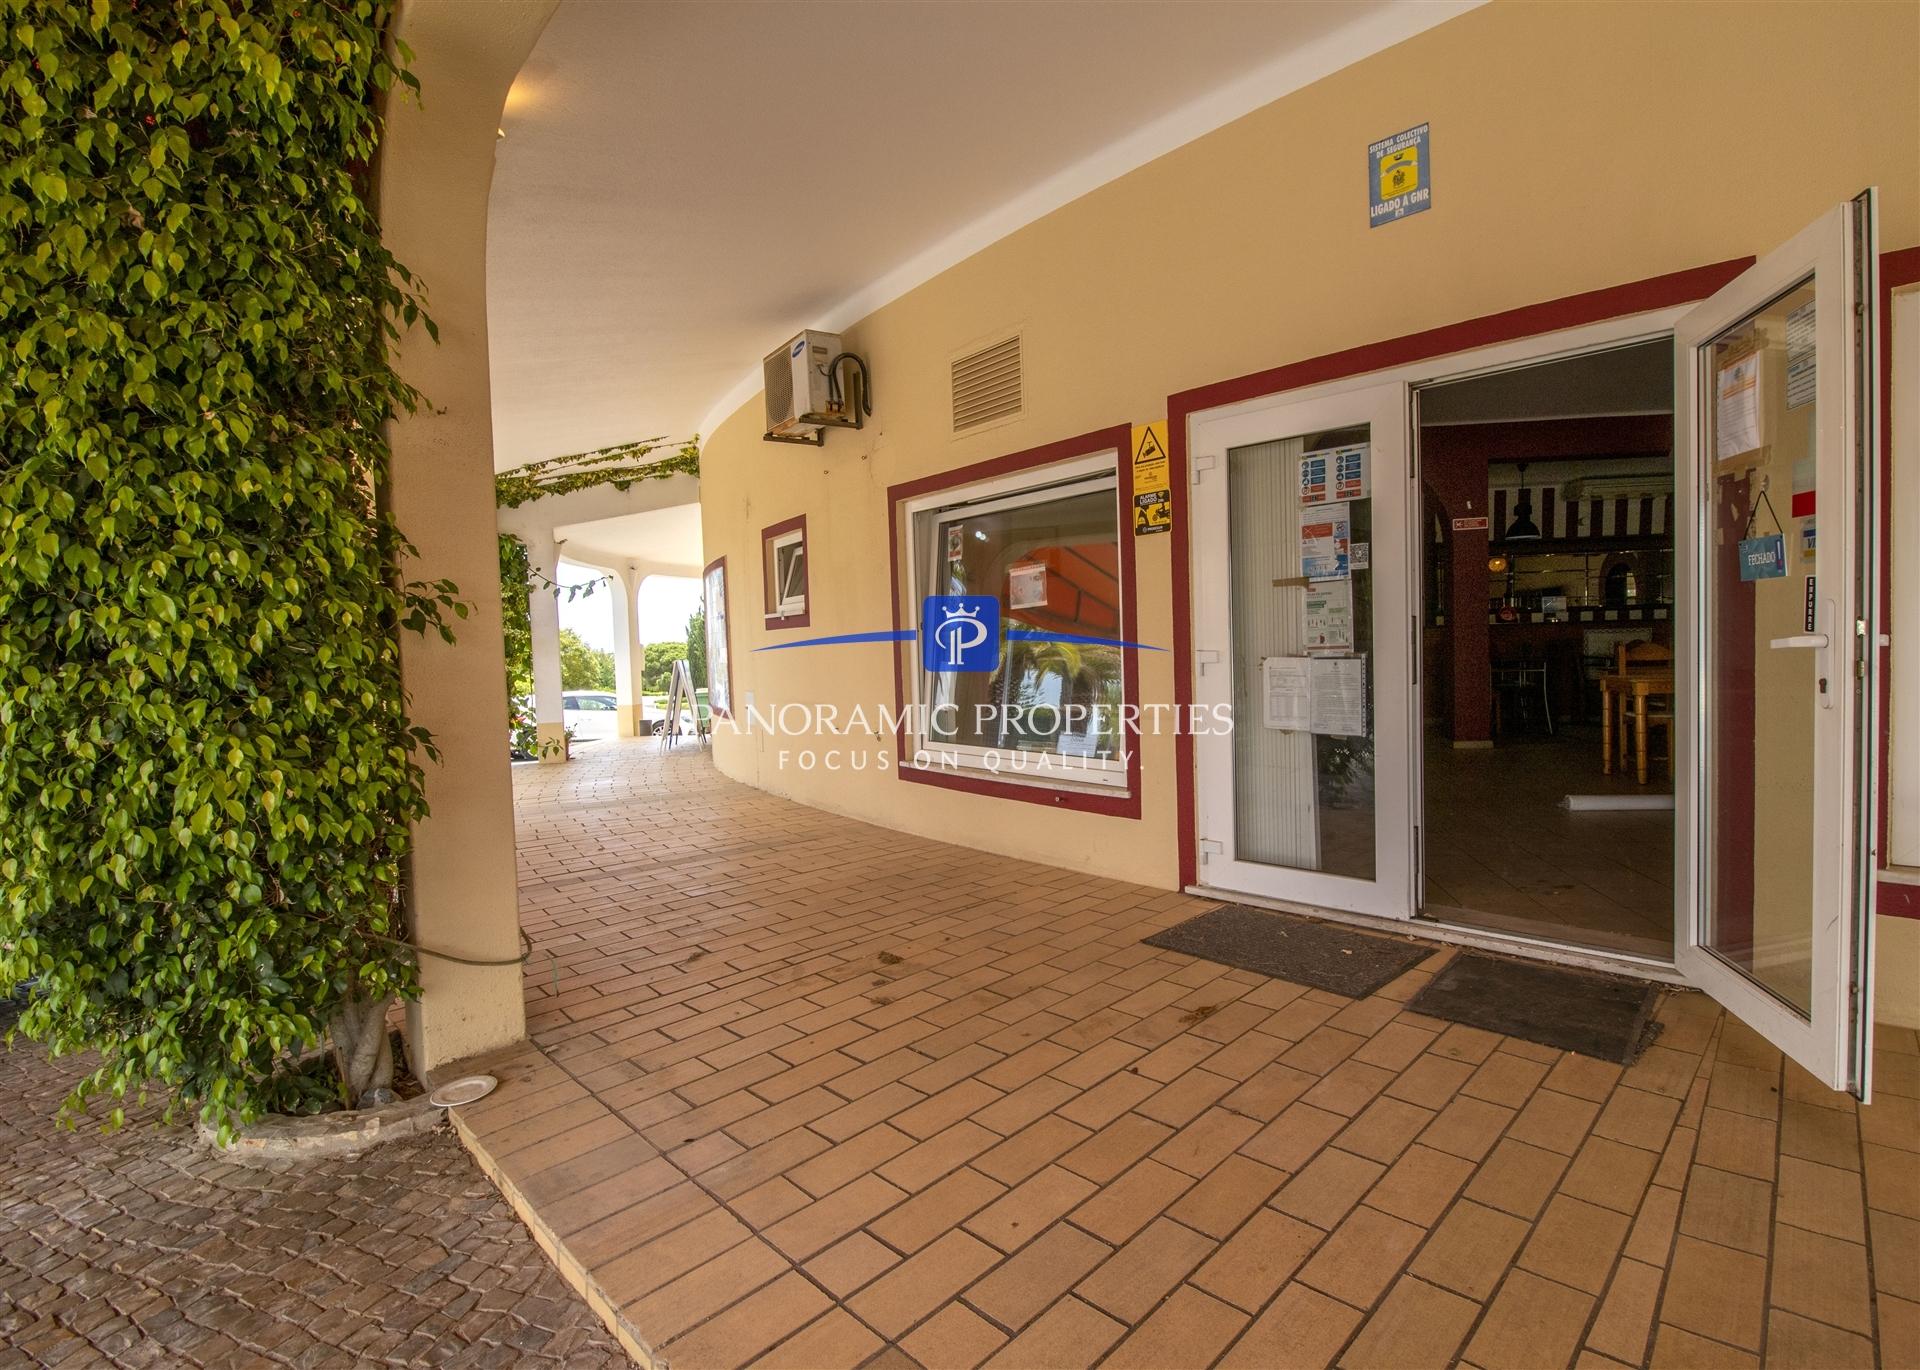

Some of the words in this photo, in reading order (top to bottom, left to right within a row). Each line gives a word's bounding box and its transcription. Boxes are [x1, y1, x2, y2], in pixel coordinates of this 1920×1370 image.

[1369, 138, 1393, 153] SISTEMA
[1396, 125, 1428, 142] COLECTIVO
[1376, 150, 1384, 159] DE
[1370, 197, 1400, 217] LIGADO
[1410, 188, 1429, 203] GNR
[1748, 551, 1776, 566] FECHADO
